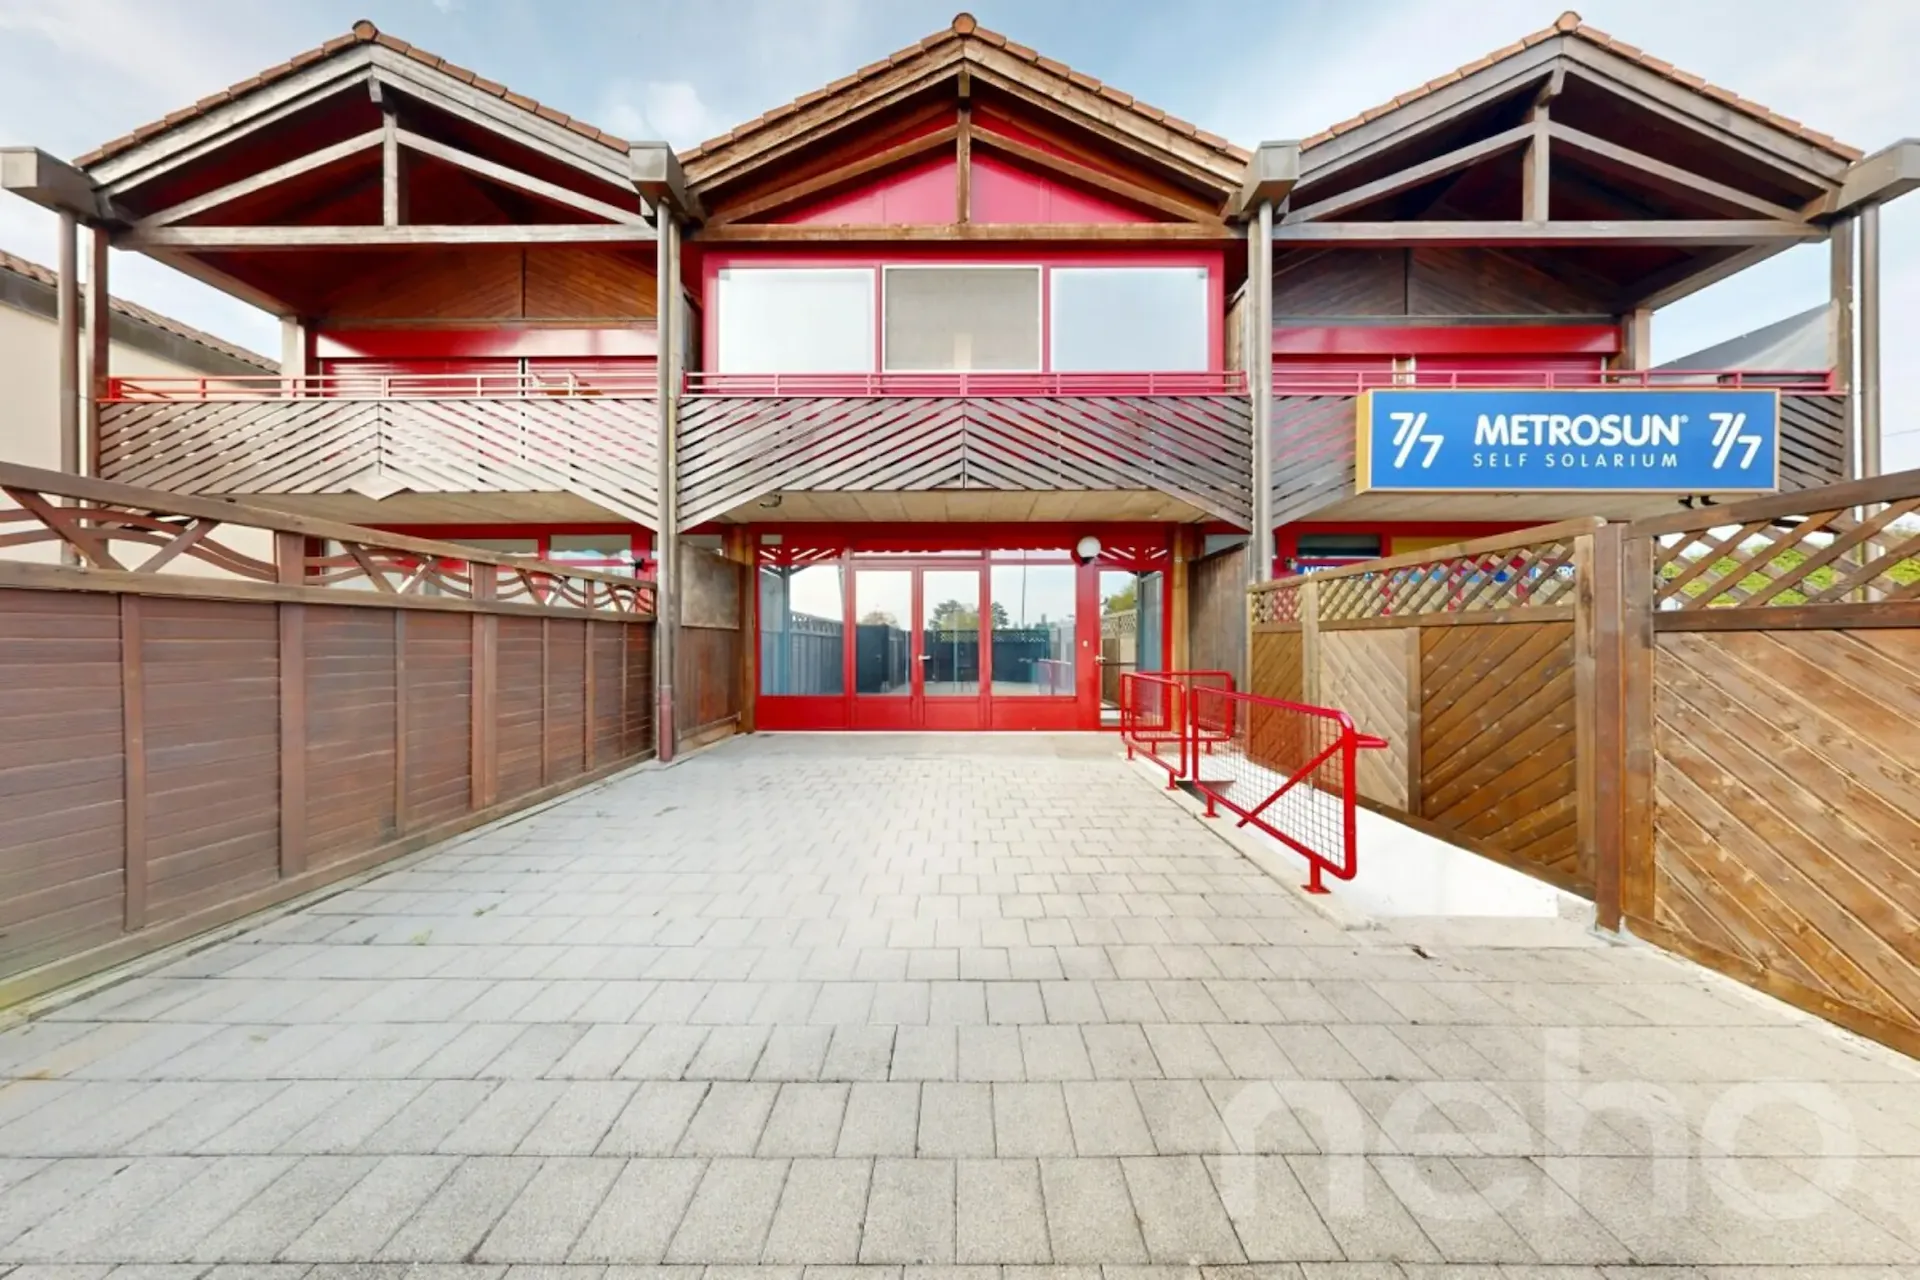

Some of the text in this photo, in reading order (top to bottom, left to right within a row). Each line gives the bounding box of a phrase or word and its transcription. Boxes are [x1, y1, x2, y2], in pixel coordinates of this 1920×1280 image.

[1389, 412, 1444, 469] 7/7
[1473, 453, 1678, 468] SELF SOLARIUM
[1708, 412, 1762, 469] 7/7
